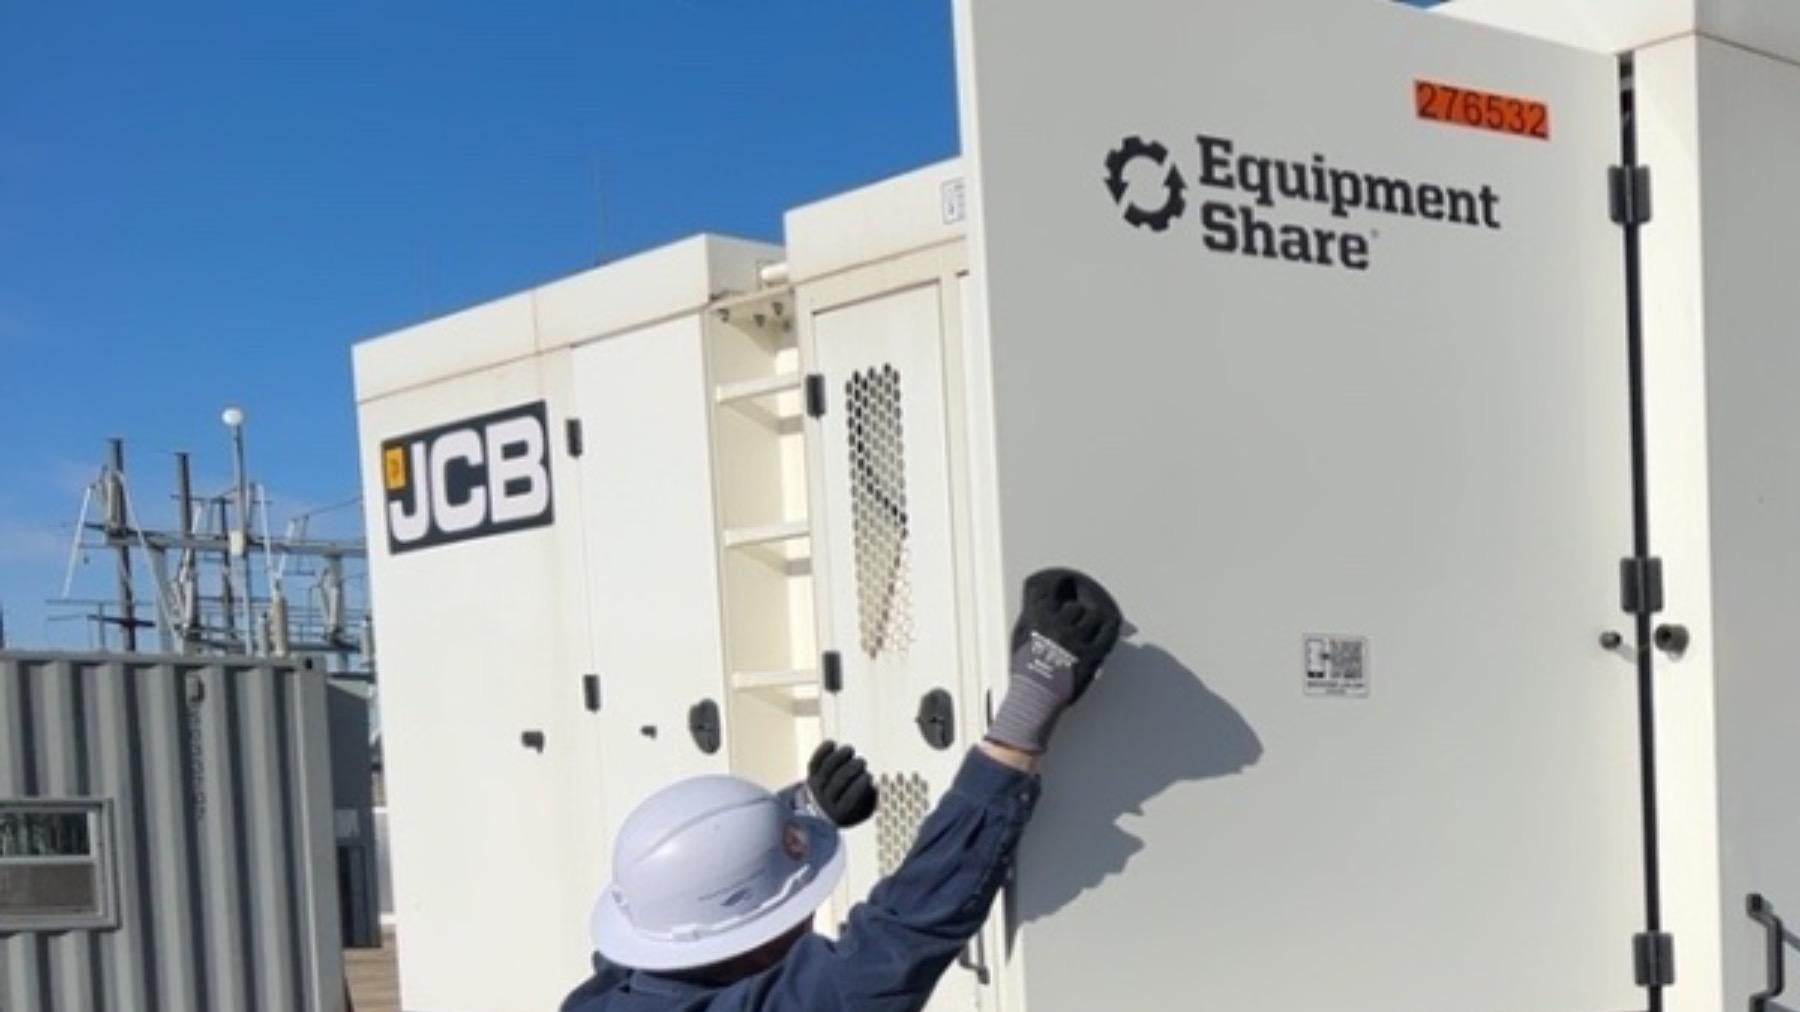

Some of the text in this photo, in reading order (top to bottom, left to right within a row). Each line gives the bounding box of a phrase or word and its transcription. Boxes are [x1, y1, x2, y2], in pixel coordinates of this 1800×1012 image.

[1416, 80, 1549, 140] 276532
[1196, 134, 1501, 229] Equipment
[1201, 200, 1369, 270] Share
[388, 415, 550, 542] JCB
